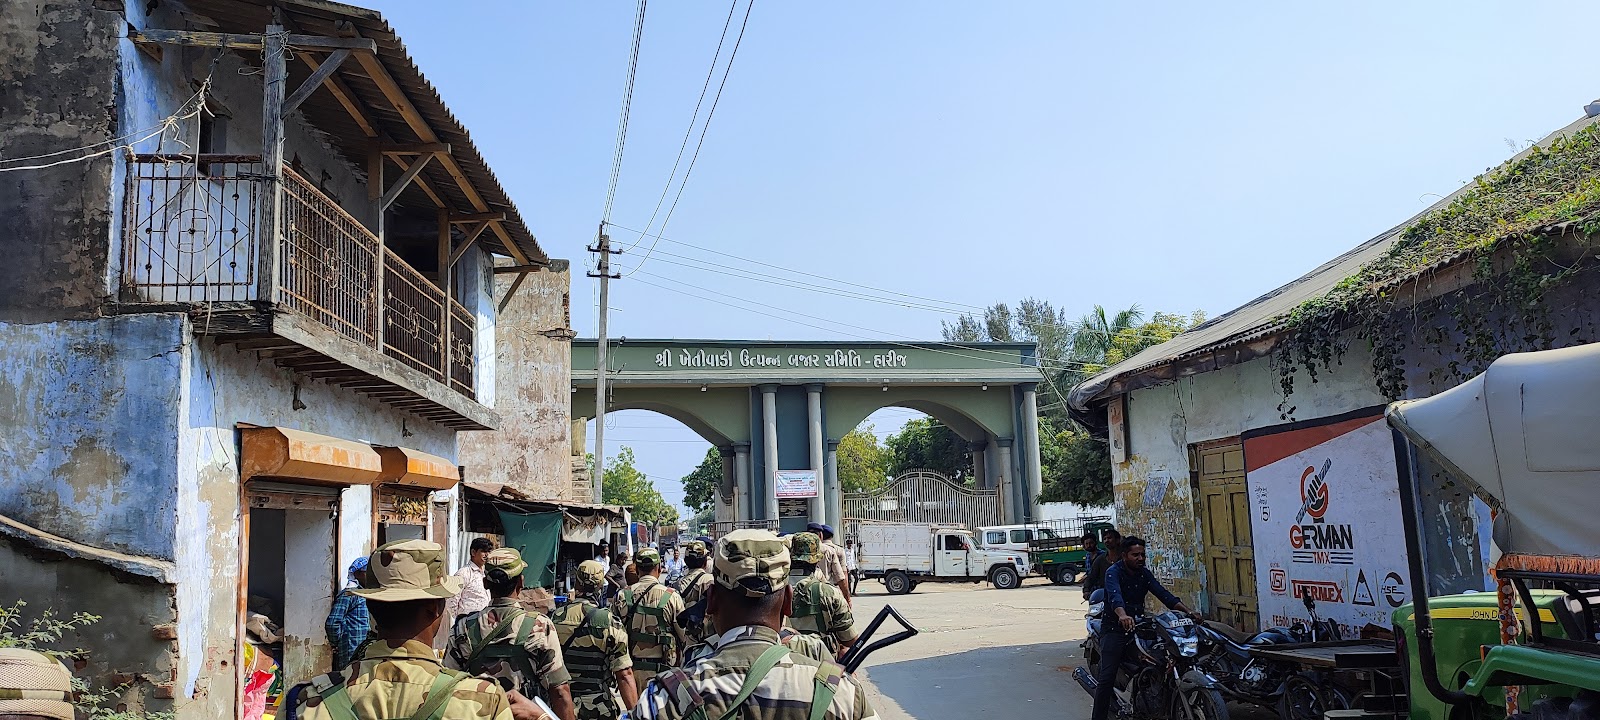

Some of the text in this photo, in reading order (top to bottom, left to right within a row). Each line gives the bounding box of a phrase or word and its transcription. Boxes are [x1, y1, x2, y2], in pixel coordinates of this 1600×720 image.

[655, 348, 672, 367] શ્રી
[679, 348, 733, 367] ખેતીવાડી
[787, 354, 820, 367] બજાર
[824, 349, 861, 367] સમિતિ
[873, 349, 907, 368] હારીજ
[1289, 524, 1354, 550] GERMAN
[1312, 551, 1330, 564] TMX
[1470, 610, 1490, 620] JOHN
